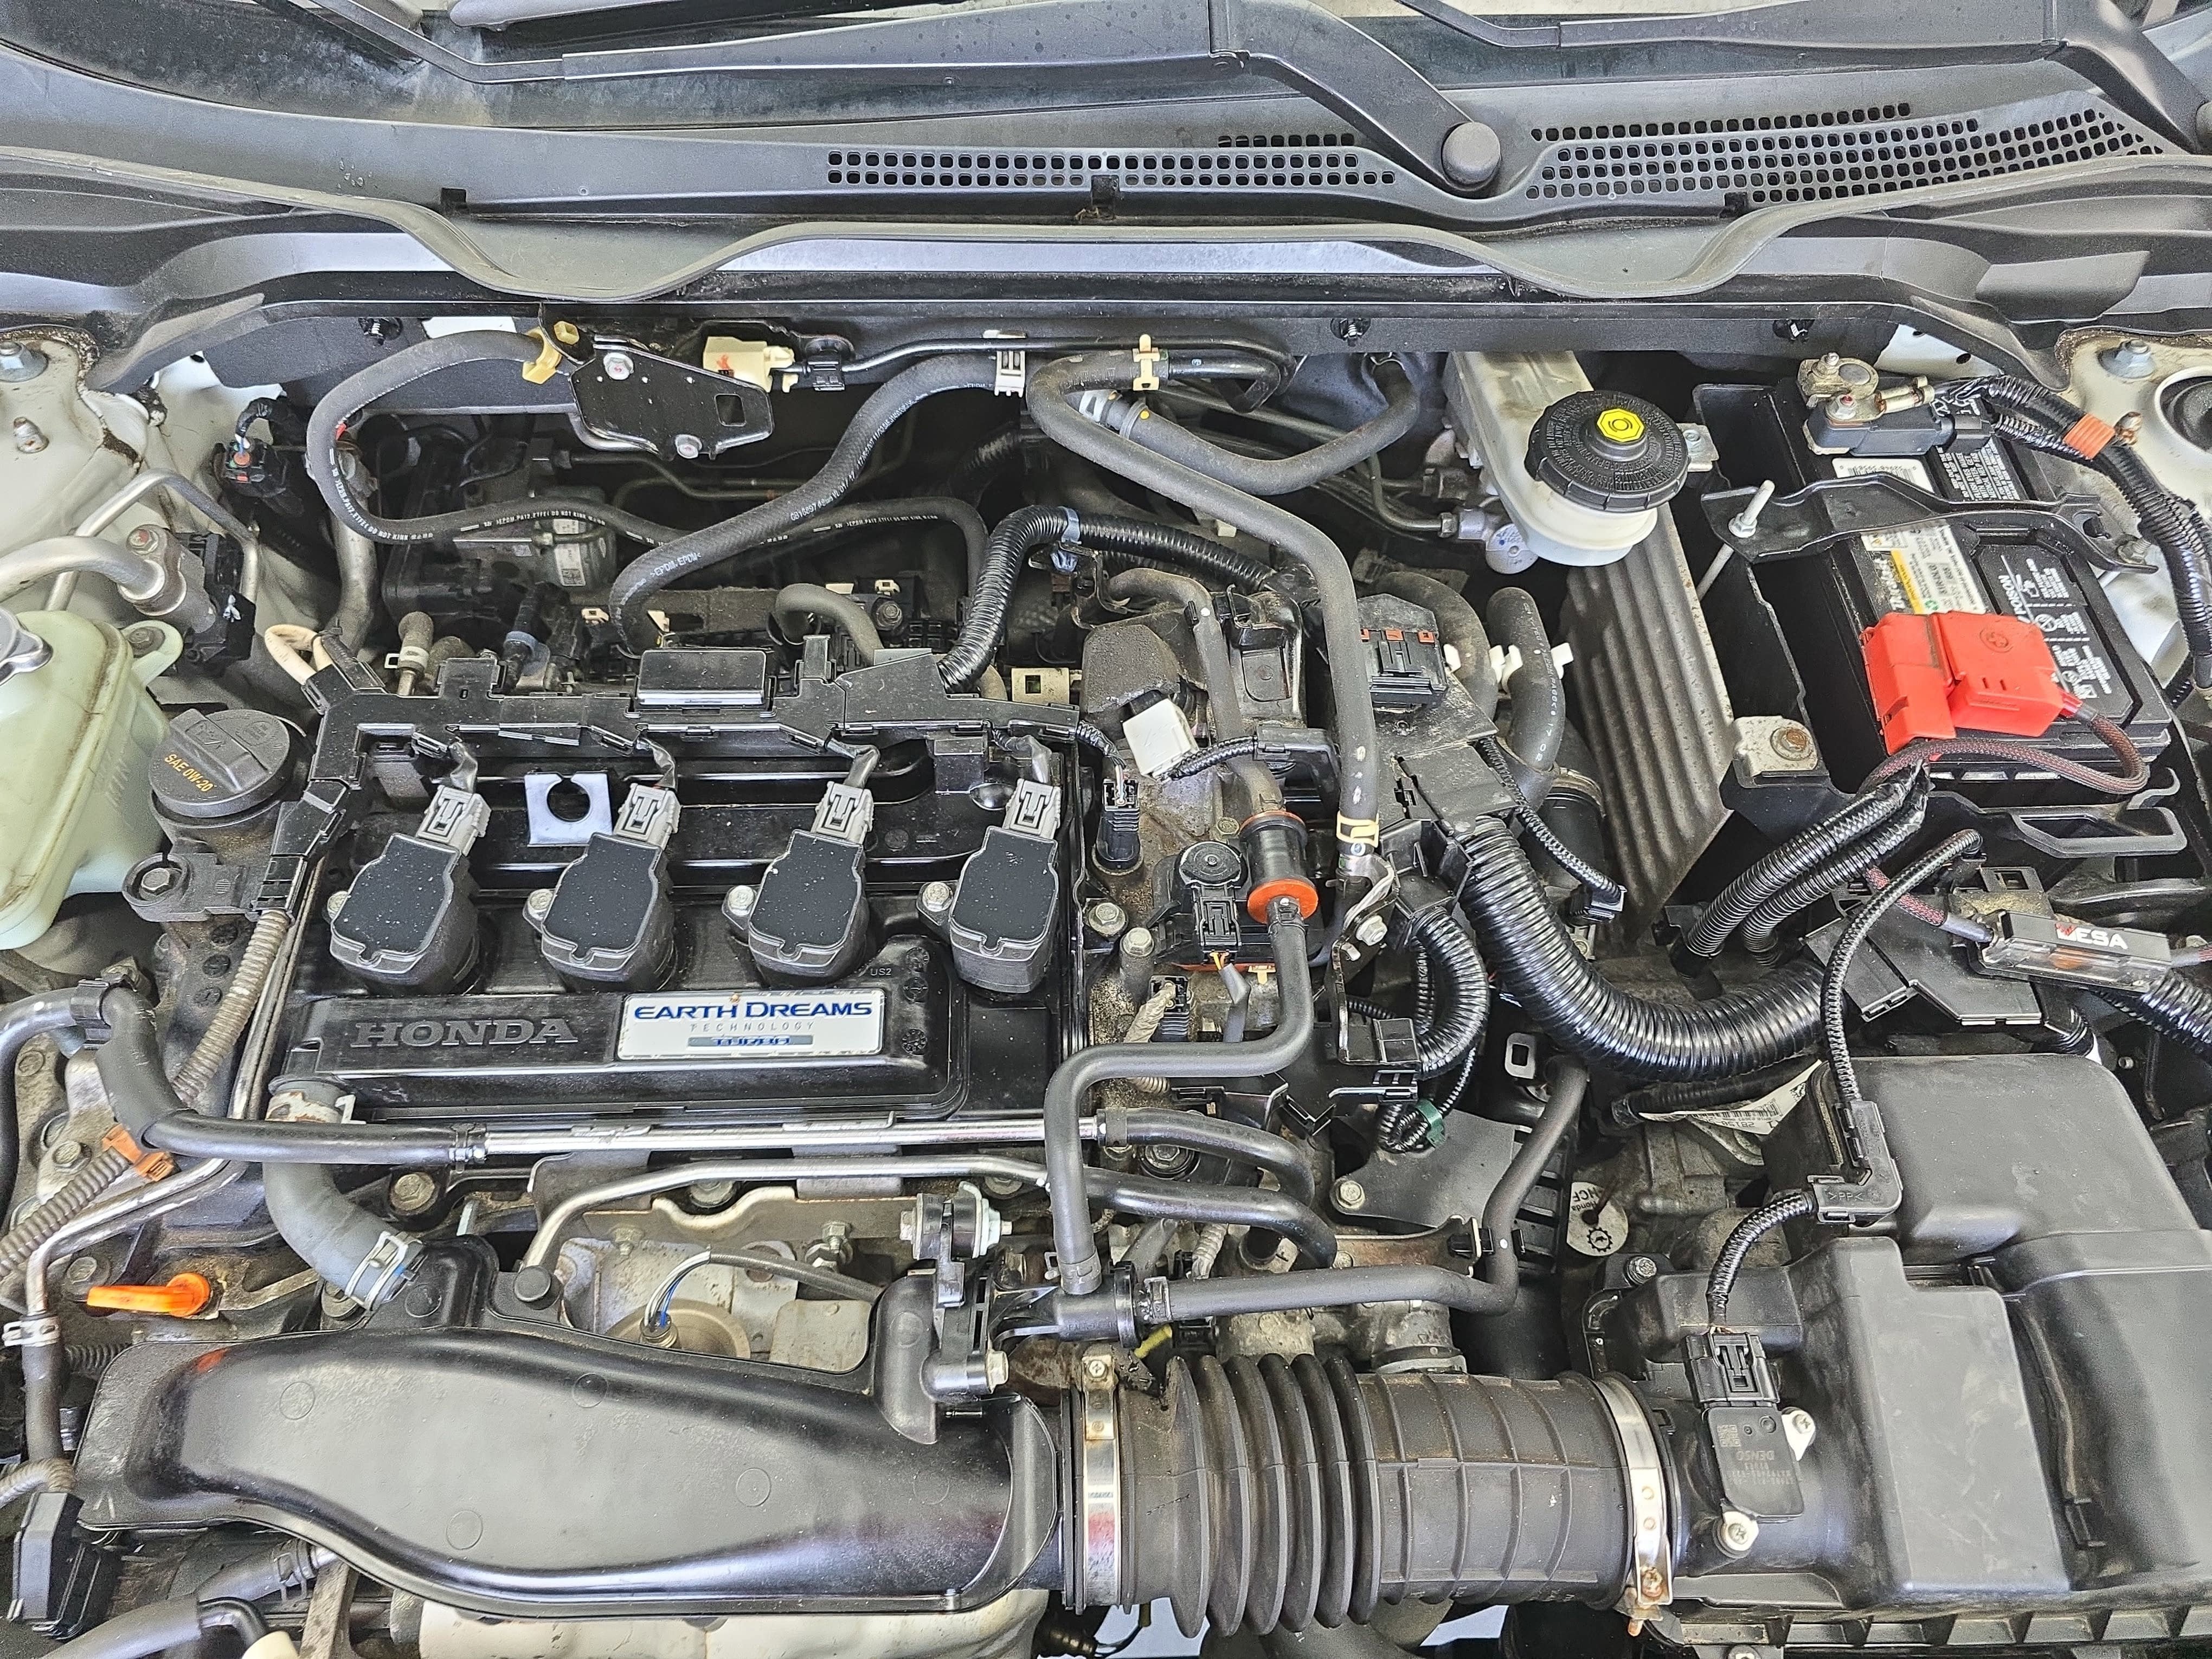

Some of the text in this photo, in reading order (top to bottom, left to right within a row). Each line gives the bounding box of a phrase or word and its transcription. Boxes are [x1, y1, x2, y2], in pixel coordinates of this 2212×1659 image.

[1964, 455, 1974, 466] GET
[1963, 468, 1974, 481] EYES
[1975, 464, 1986, 476] HELP
[1969, 482, 1983, 498] FLUSH
[1978, 485, 1989, 498] WITH
[1982, 477, 1997, 498] MEDICAL
[378, 531, 391, 539] NOT
[1998, 575, 2027, 615] POISON
[164, 754, 215, 793] SAE 0W-20
[870, 968, 892, 976] US2
[634, 1001, 873, 1019] EARTH DREAMS
[690, 1021, 815, 1032] TECHNOLOGY
[350, 1018, 578, 1049] HONDA
[711, 1036, 790, 1046] TURBO
[1828, 1192, 1863, 1200] >PP<
[1736, 1450, 1774, 1460] DENSO
